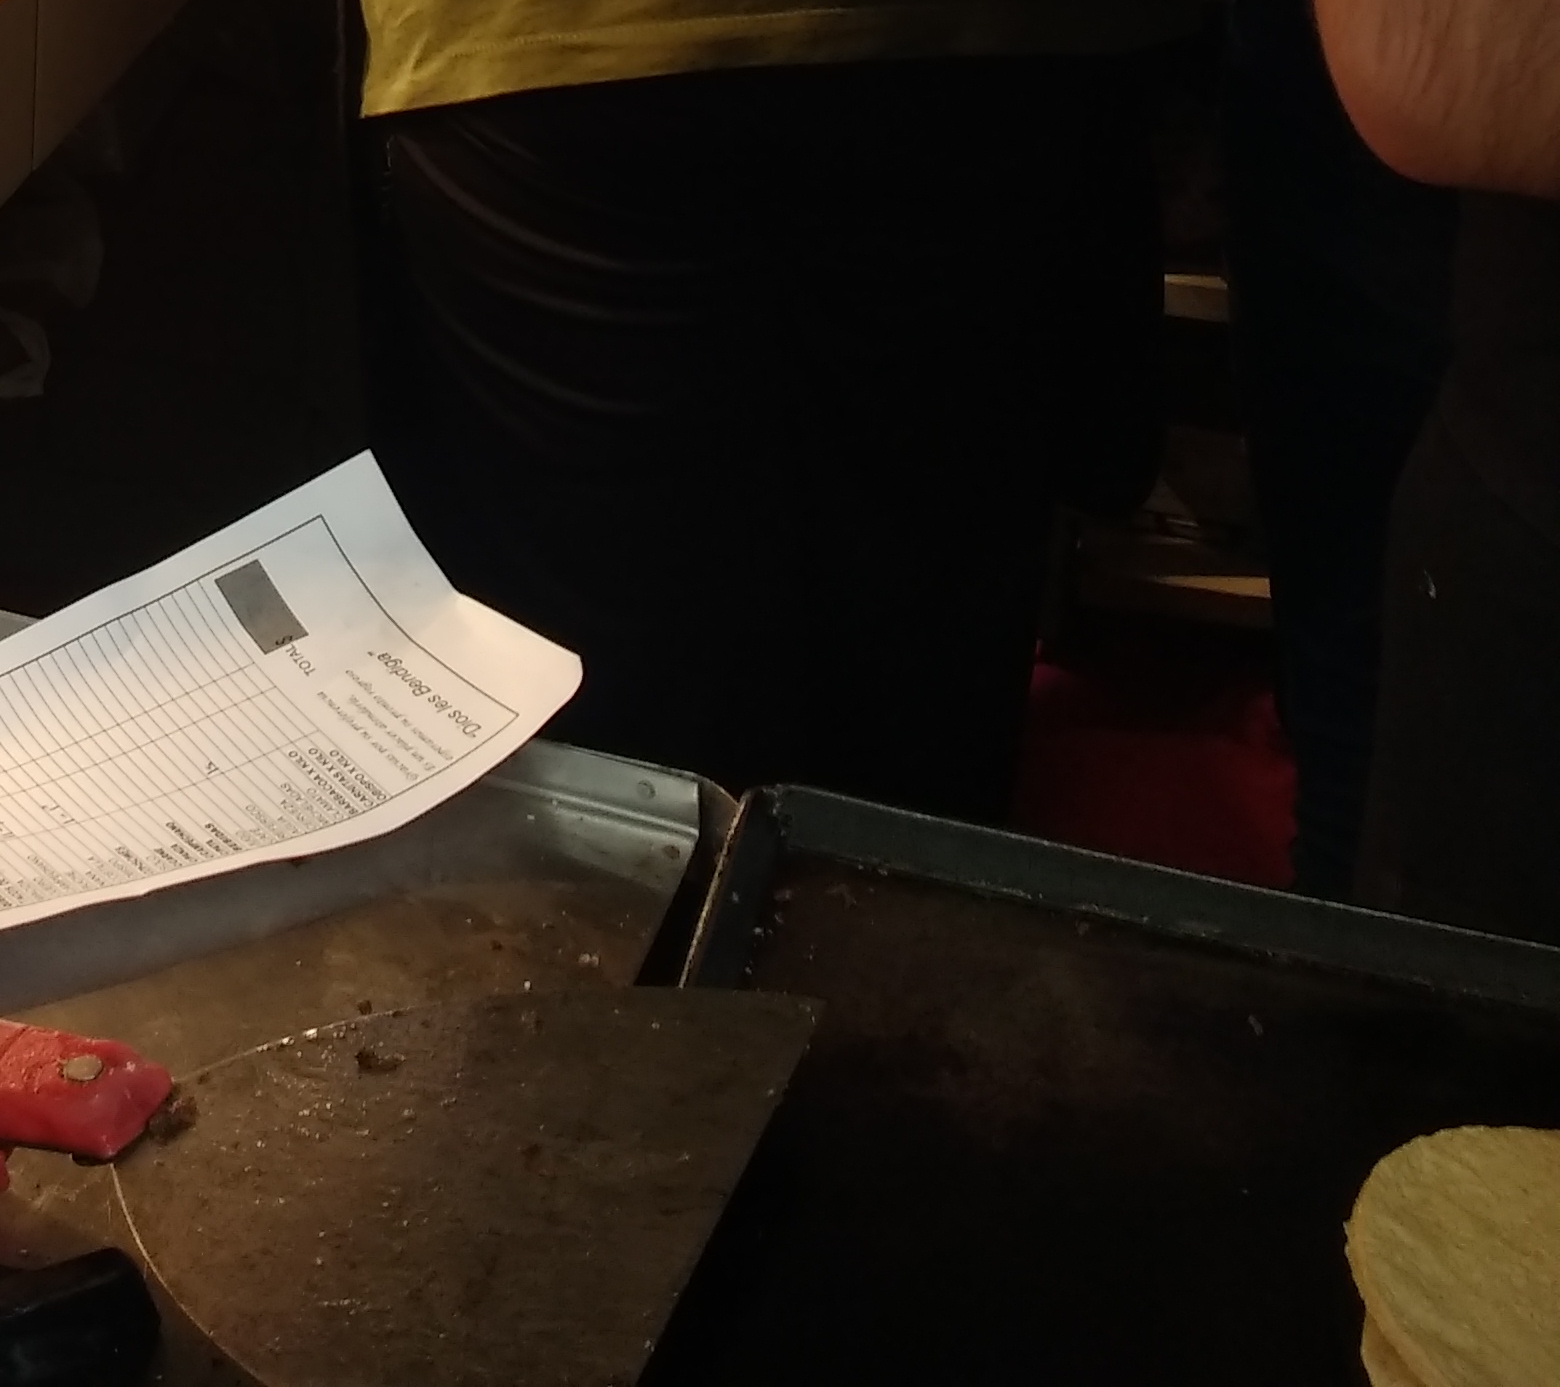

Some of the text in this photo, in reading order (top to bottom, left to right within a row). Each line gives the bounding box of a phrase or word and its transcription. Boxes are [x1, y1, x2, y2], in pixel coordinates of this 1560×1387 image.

[284, 642, 316, 676] TOTAL
[427, 693, 452, 712] les
[287, 749, 310, 767] KILO
[307, 746, 330, 765] KILO
[329, 748, 351, 767] KILO
[313, 773, 358, 814] BARBACOA
[332, 770, 374, 806] CARNITAS
[354, 771, 387, 800] OBISPO
[201, 821, 242, 852] BEBIDAS
